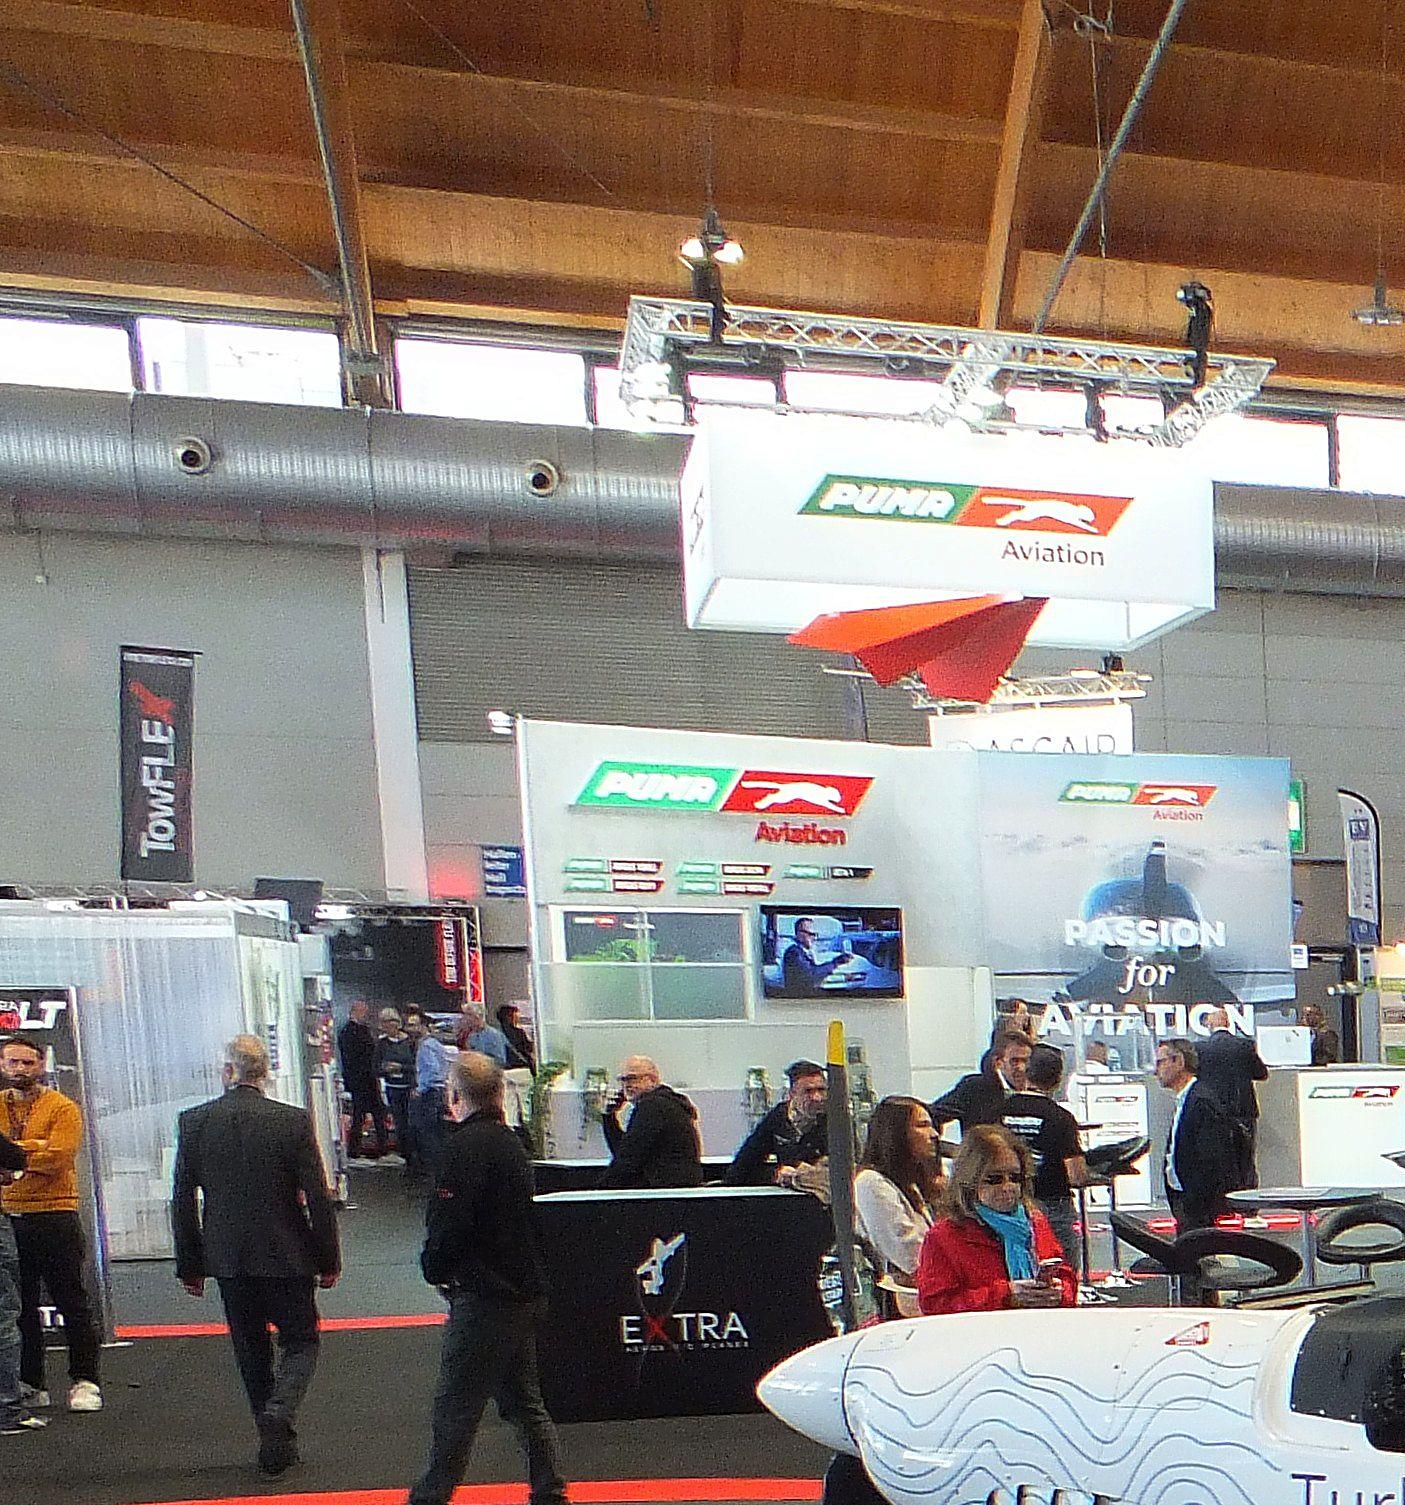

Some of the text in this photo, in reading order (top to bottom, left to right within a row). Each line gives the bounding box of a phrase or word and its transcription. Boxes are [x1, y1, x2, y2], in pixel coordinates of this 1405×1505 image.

[819, 480, 956, 519] PUMA
[1001, 540, 1105, 567] Aviation
[596, 770, 721, 804] PUMA
[1152, 809, 1204, 822] Aviation
[755, 820, 849, 846] Aviation
[1064, 918, 1227, 948] PASSION
[1118, 954, 1175, 994] for
[621, 1311, 749, 1344] EXTRA
